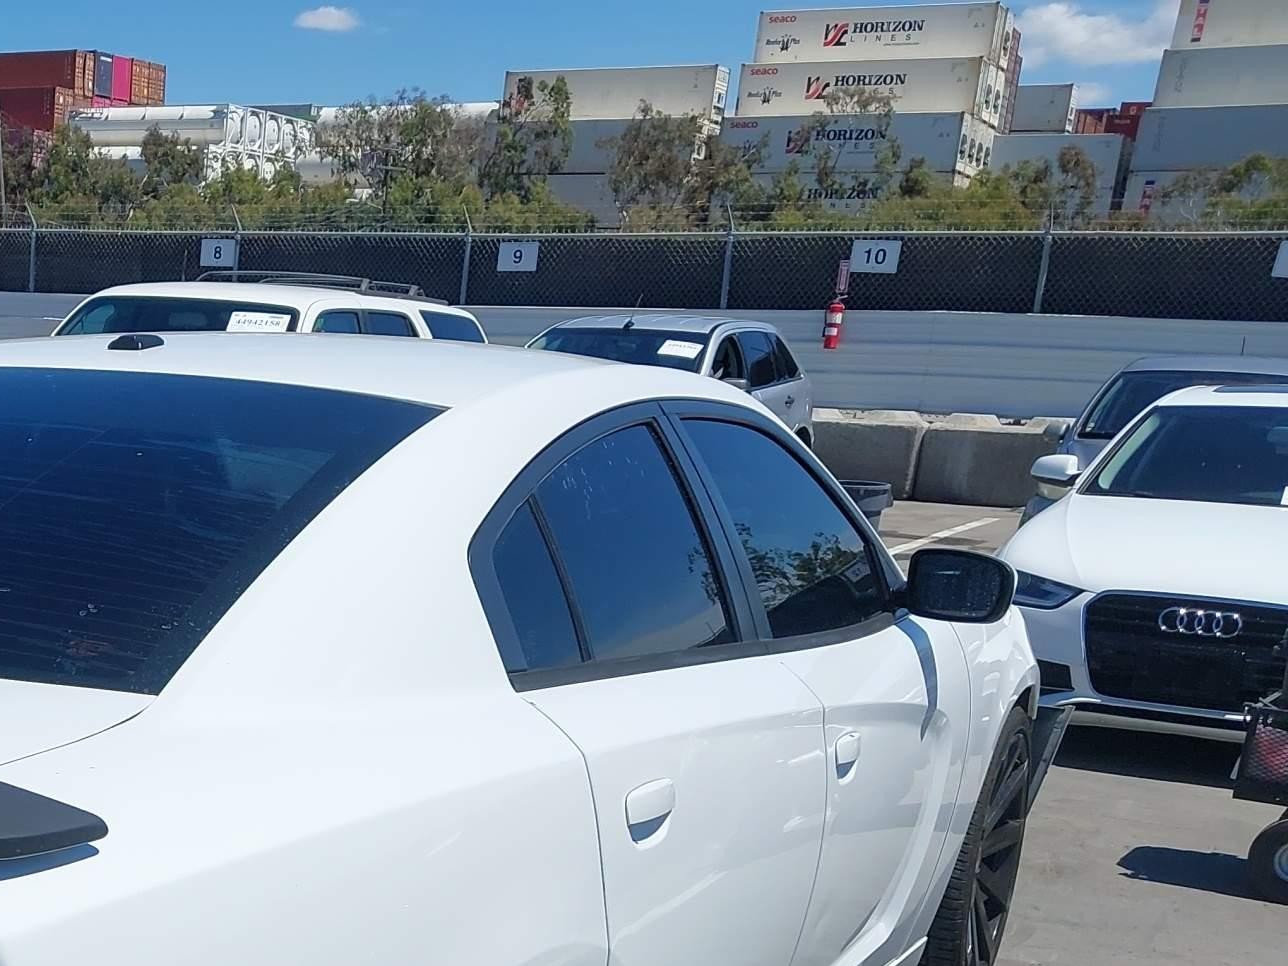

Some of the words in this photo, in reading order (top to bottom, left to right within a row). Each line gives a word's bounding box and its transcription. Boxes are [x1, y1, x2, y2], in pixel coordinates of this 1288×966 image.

[768, 15, 797, 24] seaco
[851, 20, 926, 34] HORIZON
[850, 33, 912, 43] LINES
[750, 67, 778, 76] seaco
[834, 74, 907, 87] HORIZON
[730, 121, 758, 129] seaco
[213, 246, 222, 260] 8
[513, 249, 523, 264] 9
[864, 247, 887, 265] 10
